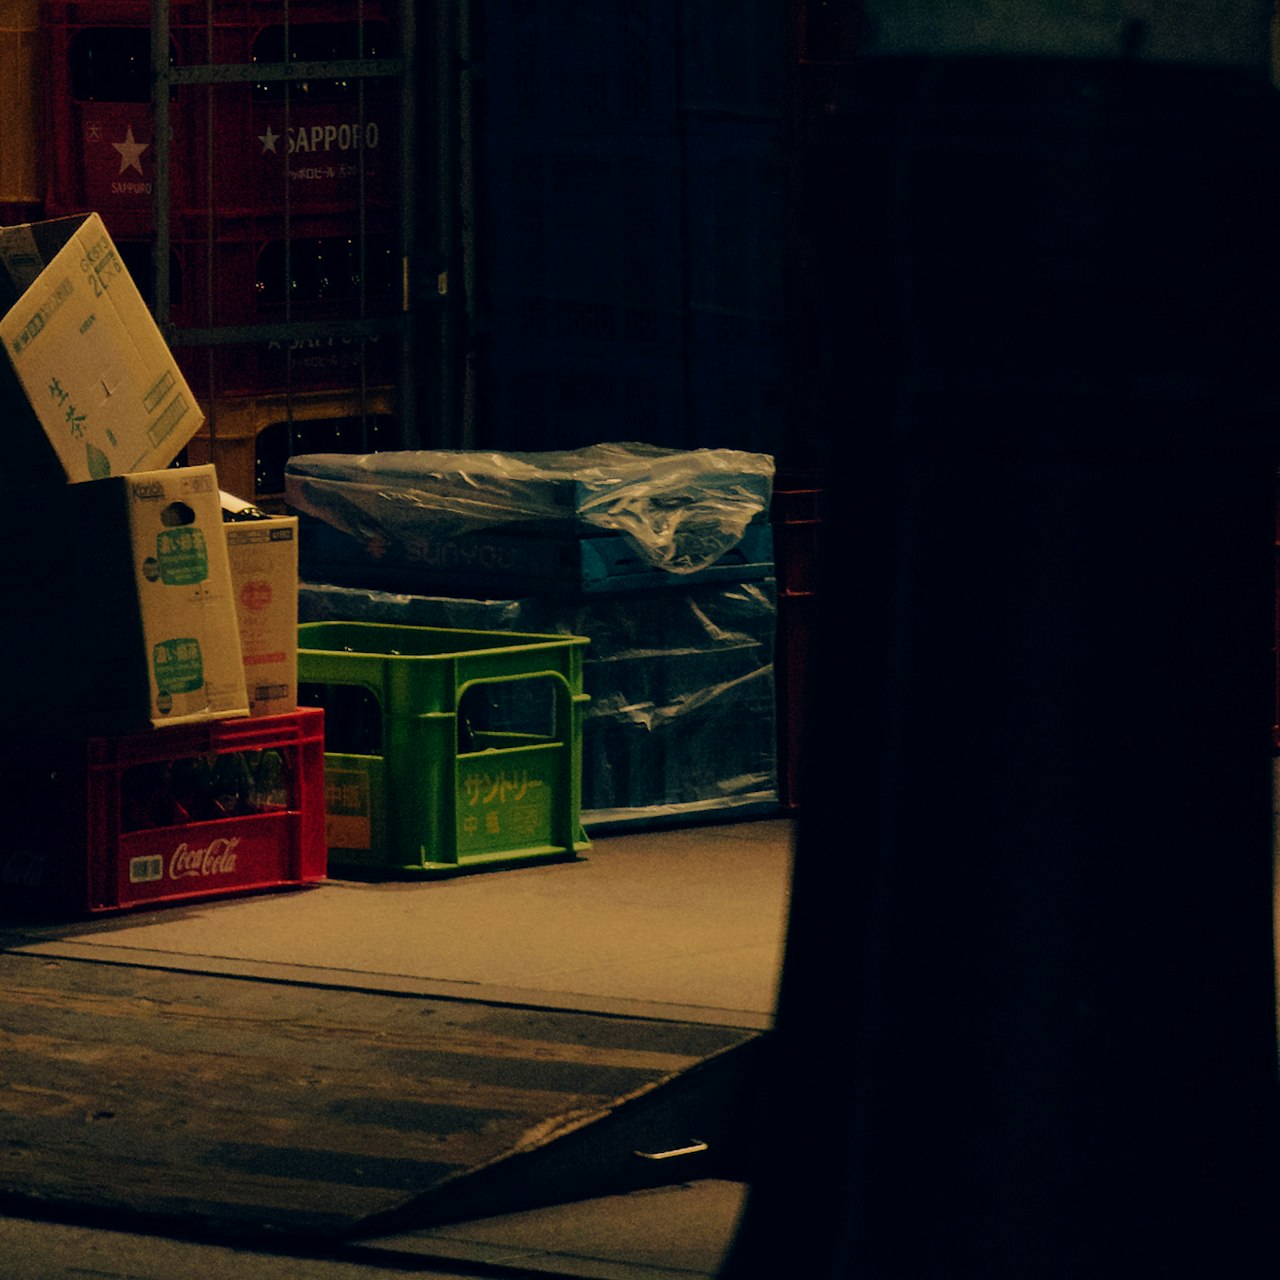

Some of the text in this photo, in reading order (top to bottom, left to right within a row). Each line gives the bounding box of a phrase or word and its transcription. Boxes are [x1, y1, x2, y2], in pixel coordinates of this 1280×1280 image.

[111, 182, 153, 195] SAPPORO
[48, 376, 89, 441] 生茶
[464, 769, 544, 806] サントリー
